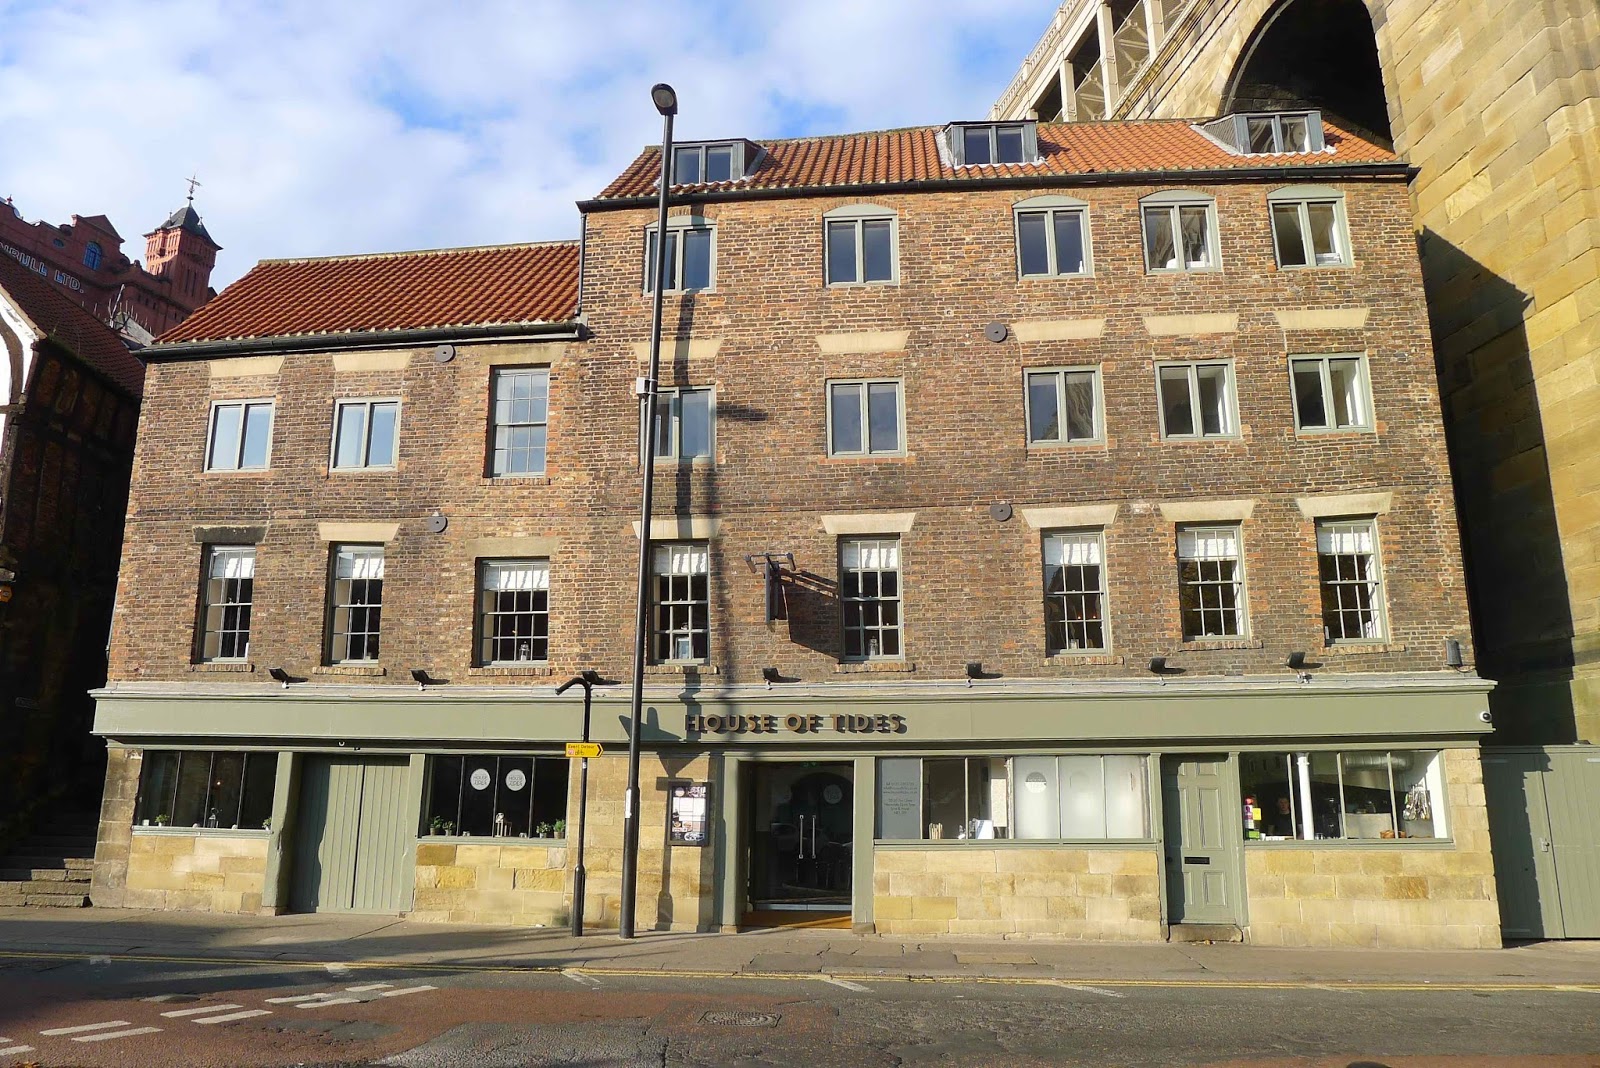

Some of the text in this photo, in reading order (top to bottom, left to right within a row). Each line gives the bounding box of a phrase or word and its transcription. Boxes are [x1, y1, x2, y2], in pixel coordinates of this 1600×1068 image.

[54, 269, 84, 294] LTD.
[685, 713, 902, 732] HOUSE OF TIDES
